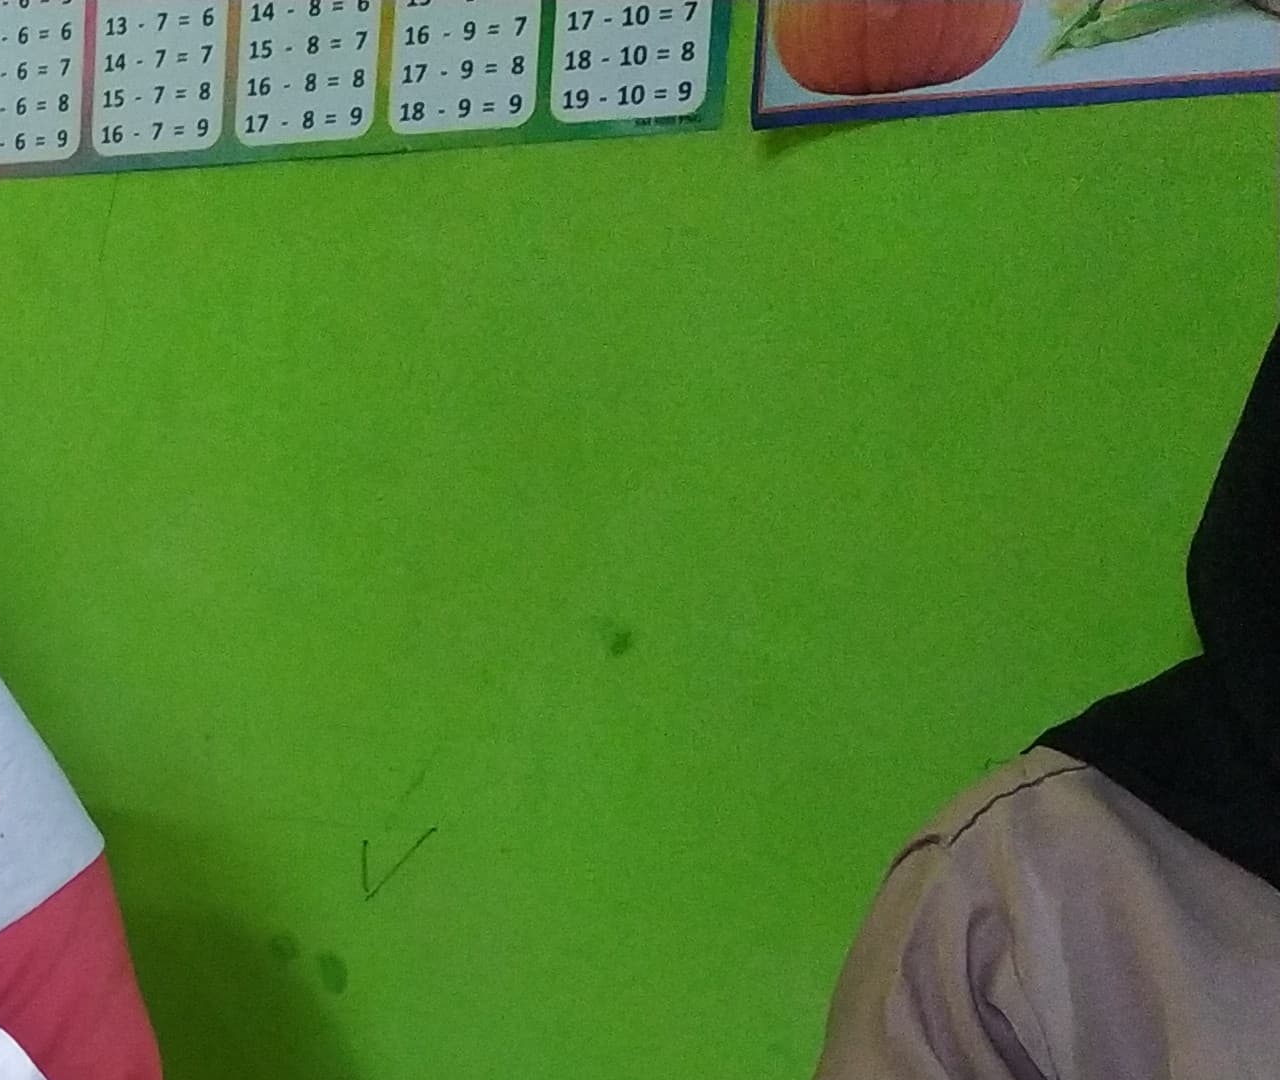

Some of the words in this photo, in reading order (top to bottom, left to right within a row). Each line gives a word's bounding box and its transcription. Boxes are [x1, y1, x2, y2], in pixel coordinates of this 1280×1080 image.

[104, 16, 128, 37] 13
[156, 11, 169, 32] 7
[202, 6, 215, 28] 6
[249, 1, 275, 23] 14
[308, 0, 322, 18] 8
[567, 8, 595, 32] 17
[621, 4, 651, 28] 10
[681, 0, 699, 23] 7
[17, 25, 29, 46] 6
[60, 21, 73, 41] 6
[248, 38, 273, 61] 15
[306, 34, 320, 56] 8
[355, 30, 369, 51] 7
[404, 24, 430, 47] 16
[463, 20, 477, 42] 9
[513, 15, 528, 37] 7
[16, 61, 29, 81] 6
[59, 57, 72, 78] 7
[103, 52, 127, 73] 14
[154, 48, 167, 69] 7
[200, 44, 214, 65] 7
[401, 63, 429, 85] 17
[460, 59, 474, 81] 9
[510, 54, 526, 76] 8
[563, 49, 592, 72] 18
[619, 44, 648, 67] 10
[680, 40, 696, 62] 8
[102, 88, 125, 109] 15
[153, 85, 166, 105] 7
[198, 81, 211, 101] 8
[246, 76, 272, 97] 16
[303, 72, 317, 93] 8
[352, 68, 366, 89] 8
[561, 88, 590, 111] 19
[617, 84, 646, 107] 10
[677, 80, 693, 103] 9
[15, 96, 28, 116] 6
[57, 93, 70, 113] 8
[398, 101, 426, 123] 18
[457, 97, 472, 119] 9
[508, 93, 523, 115] 9
[100, 124, 124, 145] 16
[151, 121, 164, 142] 7
[196, 117, 209, 138] 9
[244, 113, 270, 134] 17
[301, 109, 315, 130] 8
[349, 106, 363, 127] 9
[14, 132, 26, 152] 6
[56, 128, 69, 149] 9
